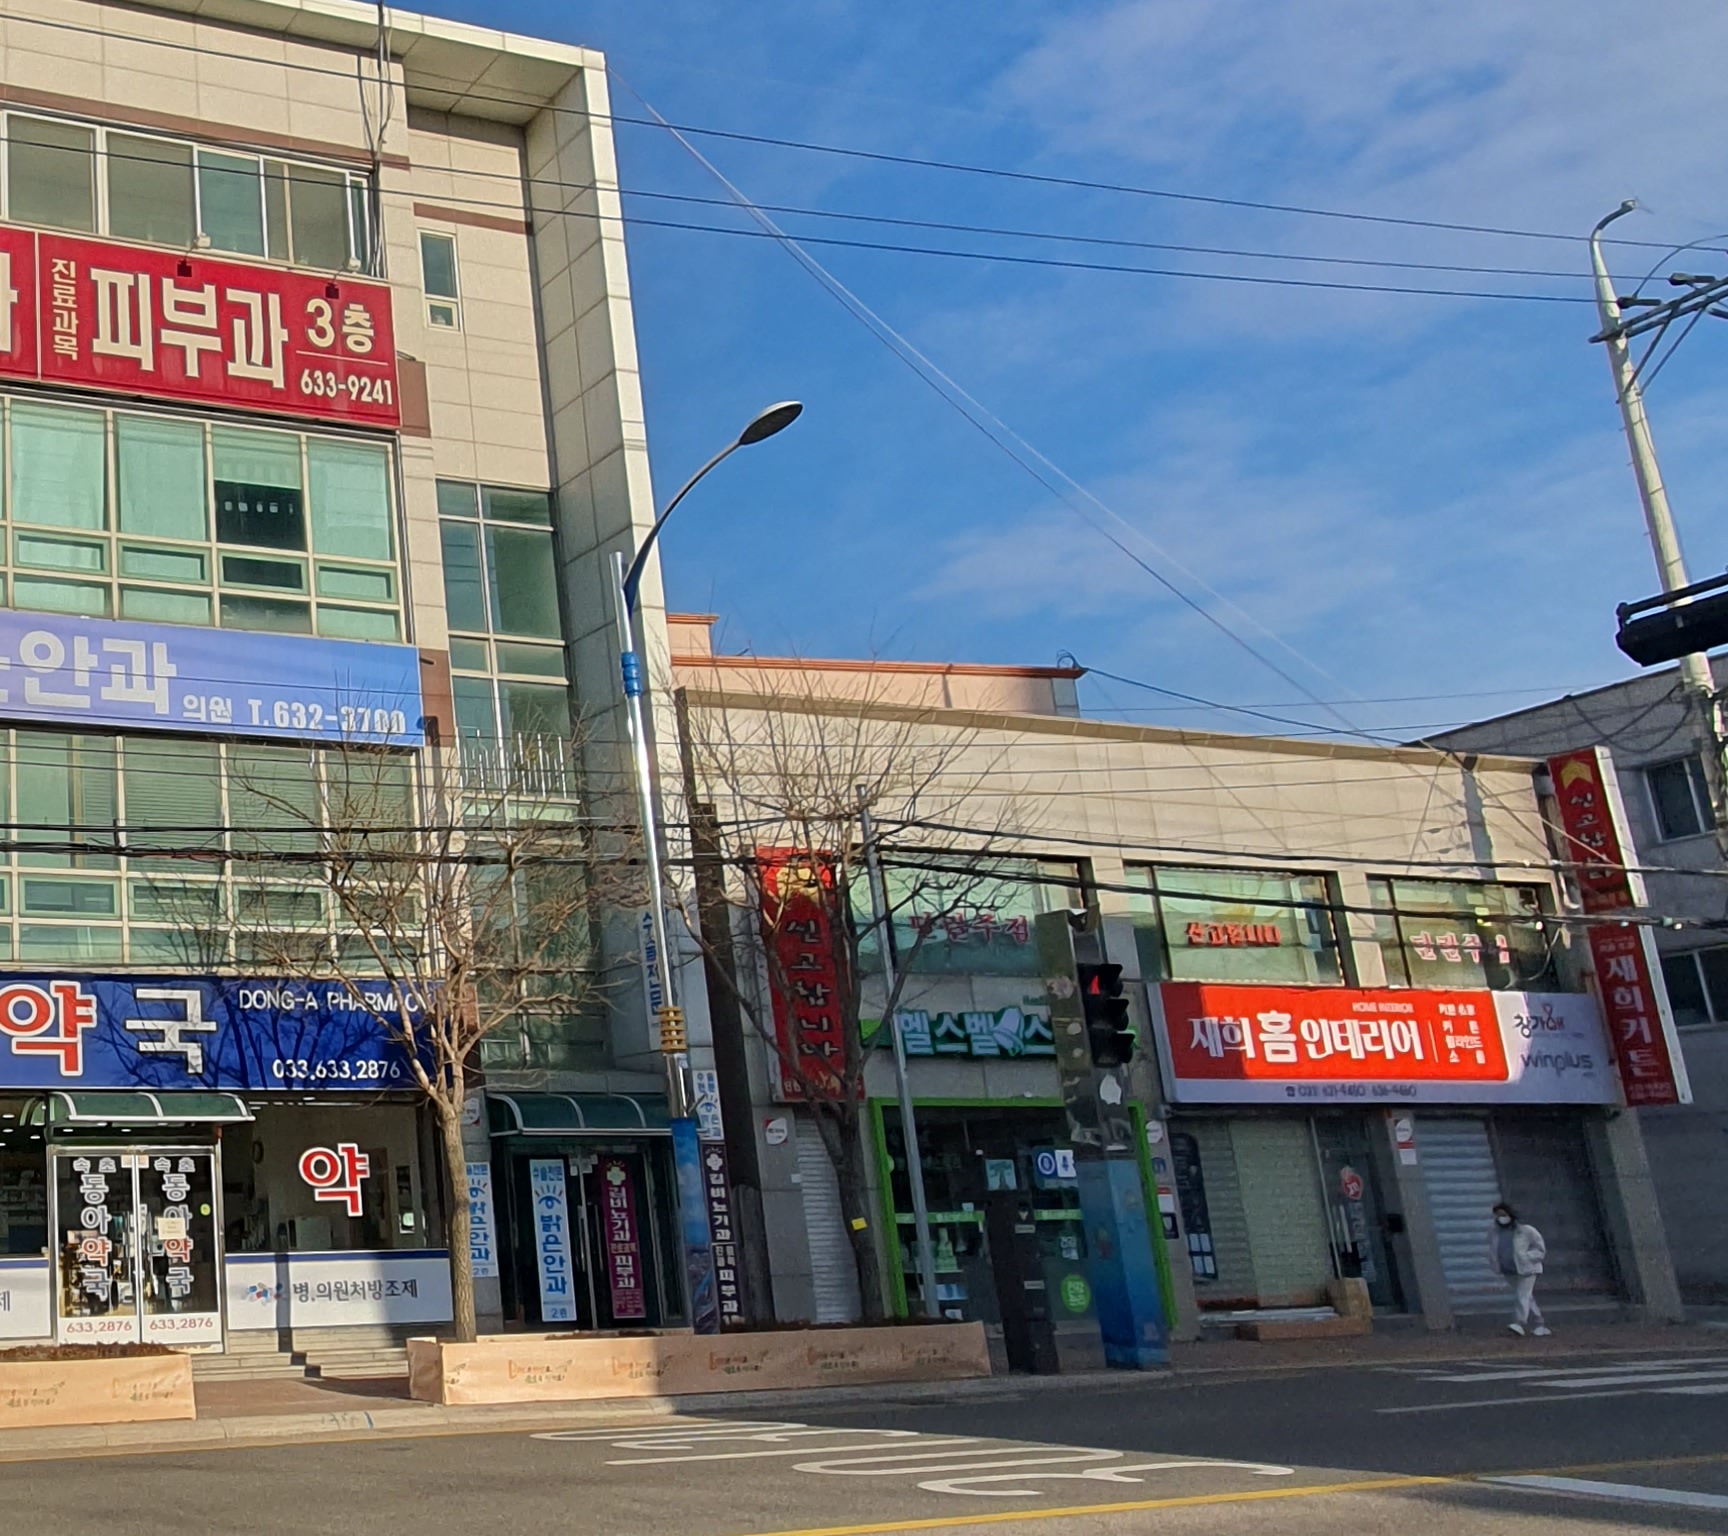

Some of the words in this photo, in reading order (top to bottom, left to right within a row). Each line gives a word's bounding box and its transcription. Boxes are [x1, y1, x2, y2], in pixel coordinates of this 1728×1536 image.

[51, 258, 78, 361] 진료과목
[90, 266, 289, 390] 피부과
[306, 298, 375, 354] 3층
[300, 368, 393, 406] 633-9241
[182, 694, 233, 724] 의원
[239, 989, 318, 1011] DONG-A
[327, 992, 432, 1013] PHARMCY
[1606, 954, 1659, 1077] 재희커튼
[272, 1059, 401, 1081] 033.633.2876
[1521, 1050, 1594, 1077] winplus
[298, 1142, 371, 1217] 약
[79, 1174, 112, 1301] 동아약국
[540, 1214, 567, 1295] 밝은안과
